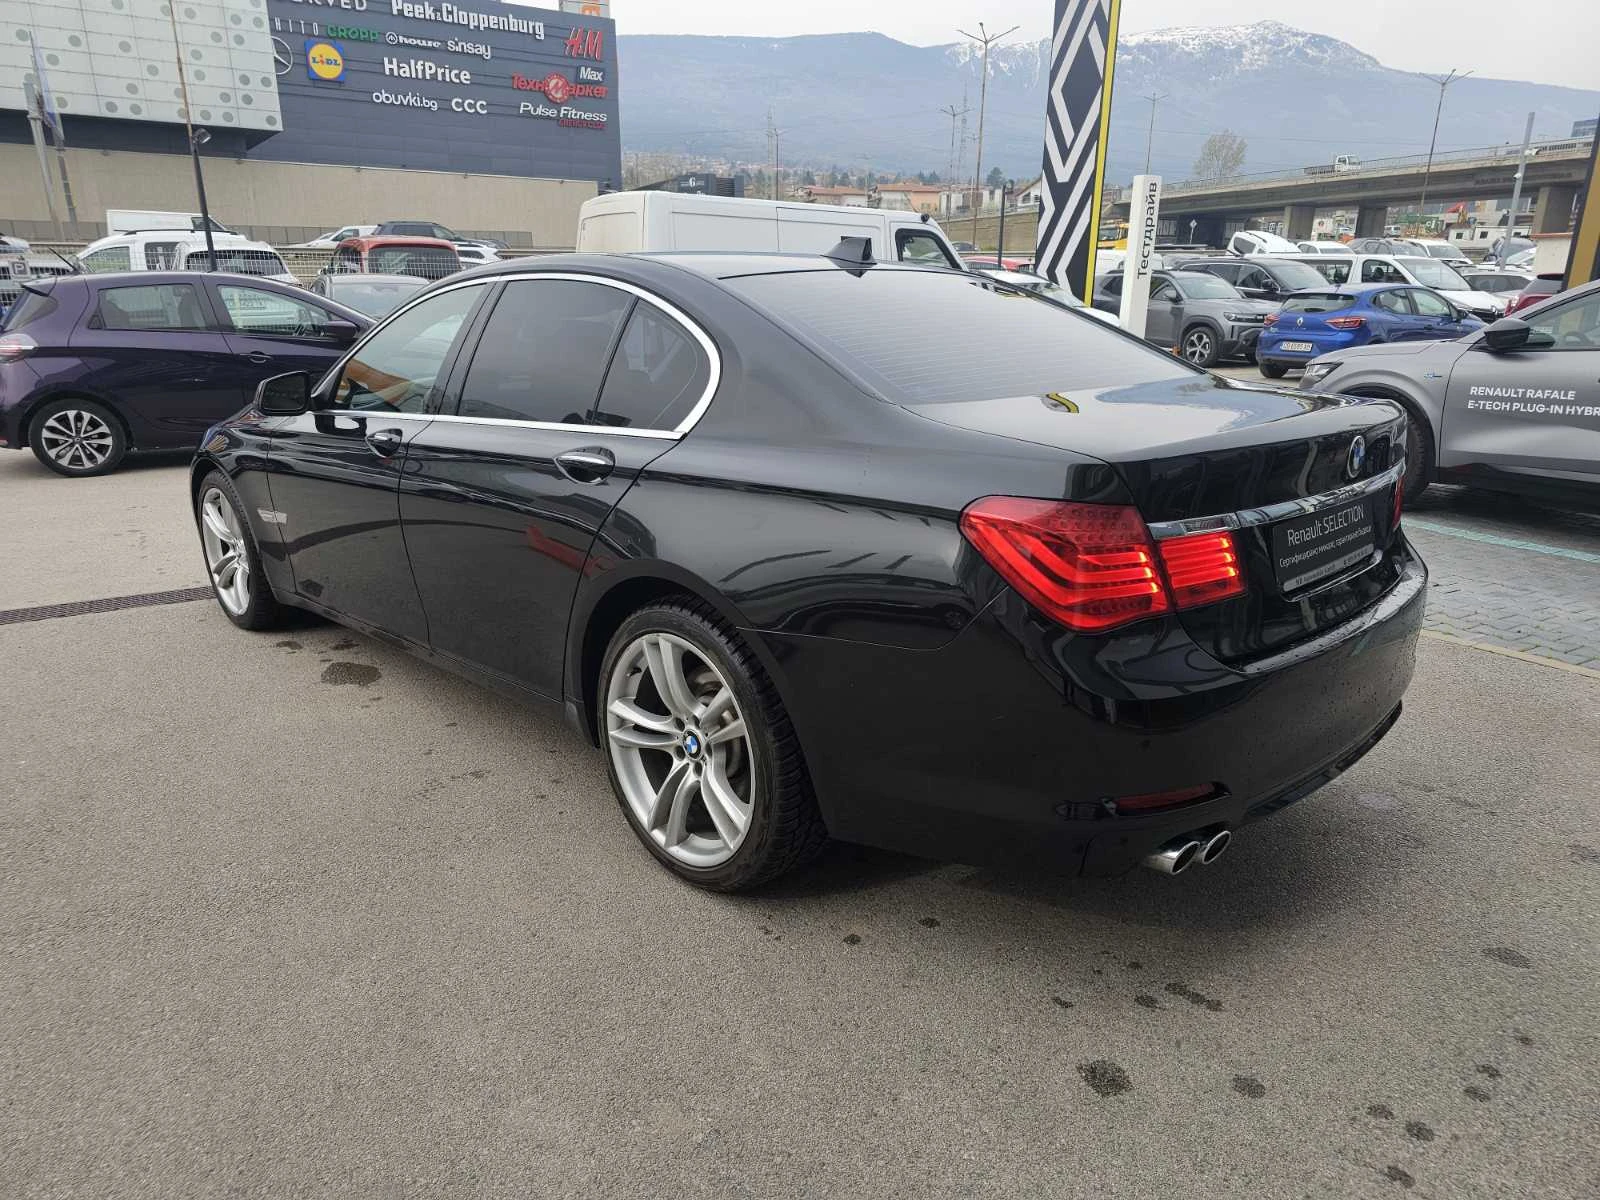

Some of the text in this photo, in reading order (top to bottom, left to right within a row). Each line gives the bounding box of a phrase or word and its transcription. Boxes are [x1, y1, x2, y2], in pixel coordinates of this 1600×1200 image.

[327, 24, 379, 41] CROPP
[383, 56, 471, 84] HalfPrice
[579, 66, 604, 81] Max
[372, 89, 438, 111] obuvki.bg
[451, 98, 488, 114] CCC
[519, 102, 607, 122] Pulse Fitness
[1137, 182, 1157, 279] Тестдрайв
[1470, 386, 1576, 400] RENAULT RAFALE
[1467, 400, 1510, 411] E-TECH
[1512, 403, 1563, 414] PLUG-IN
[1287, 504, 1364, 547] Renault SELECTION
